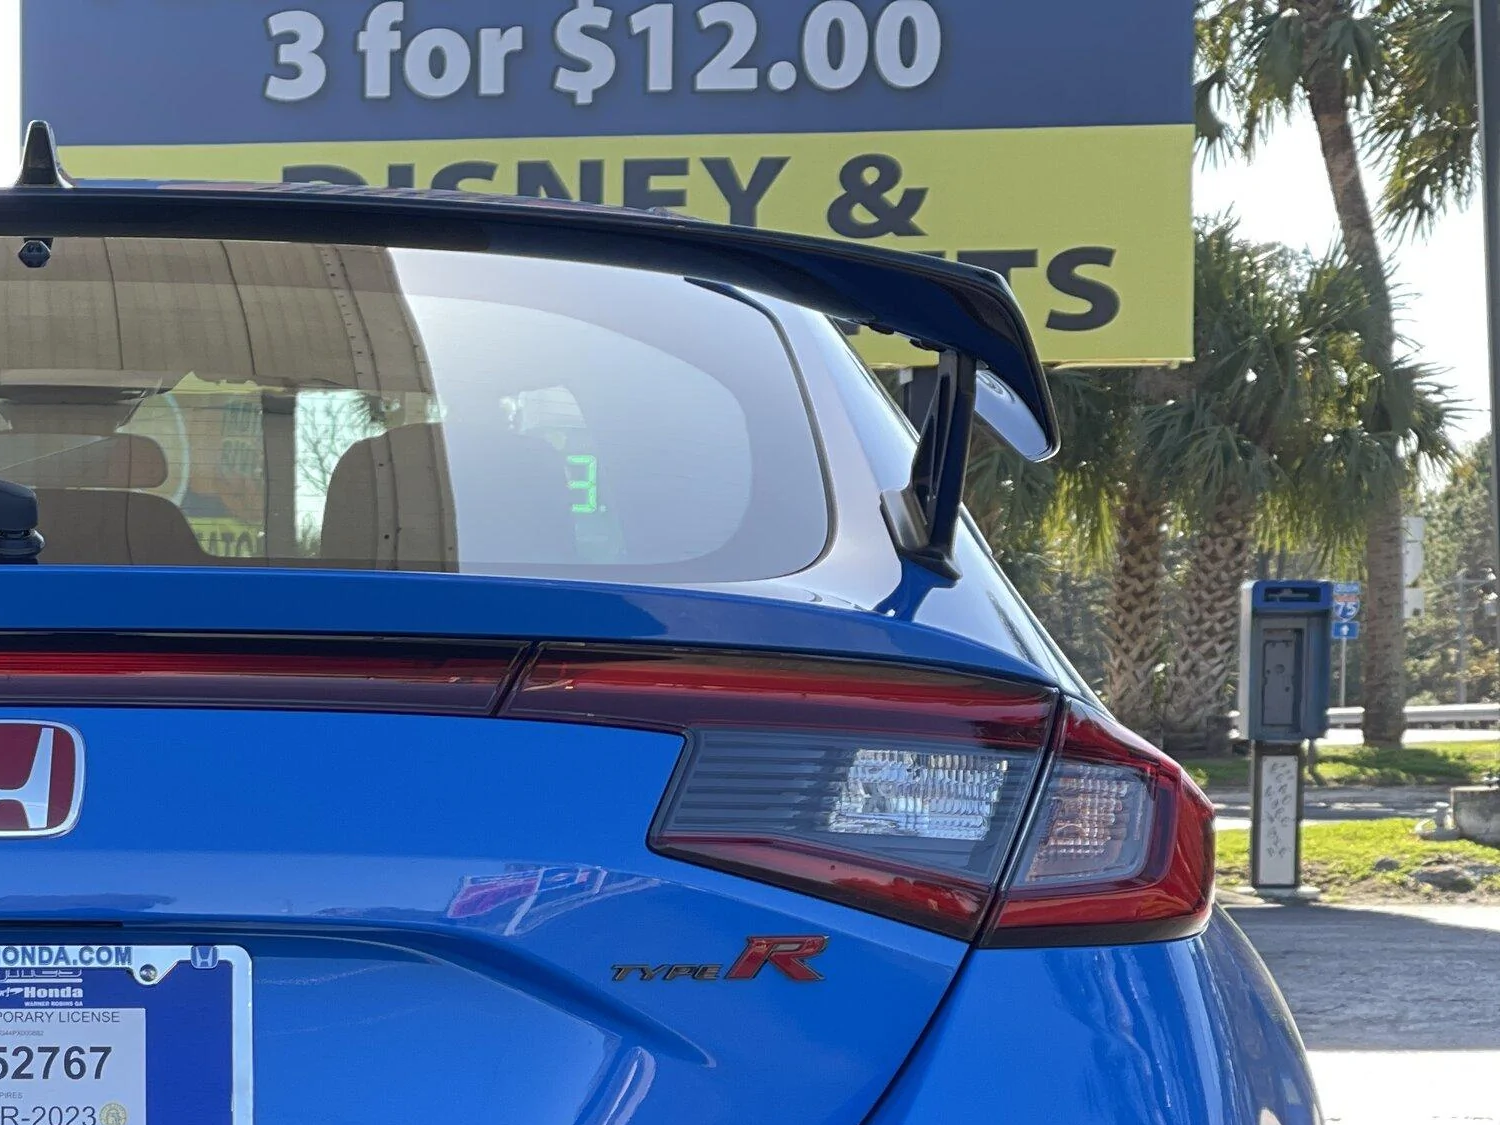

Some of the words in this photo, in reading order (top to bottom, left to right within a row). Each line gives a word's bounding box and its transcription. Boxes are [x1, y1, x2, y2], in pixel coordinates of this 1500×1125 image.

[264, 10, 328, 101] 3
[358, 1, 522, 98] for
[553, 0, 942, 105] $12.00
[827, 153, 929, 239] &
[1333, 601, 1357, 617] 75
[611, 963, 722, 981] TYPE
[723, 934, 830, 981] R
[23, 986, 84, 999] Honda
[58, 1011, 121, 1024] LICENSE
